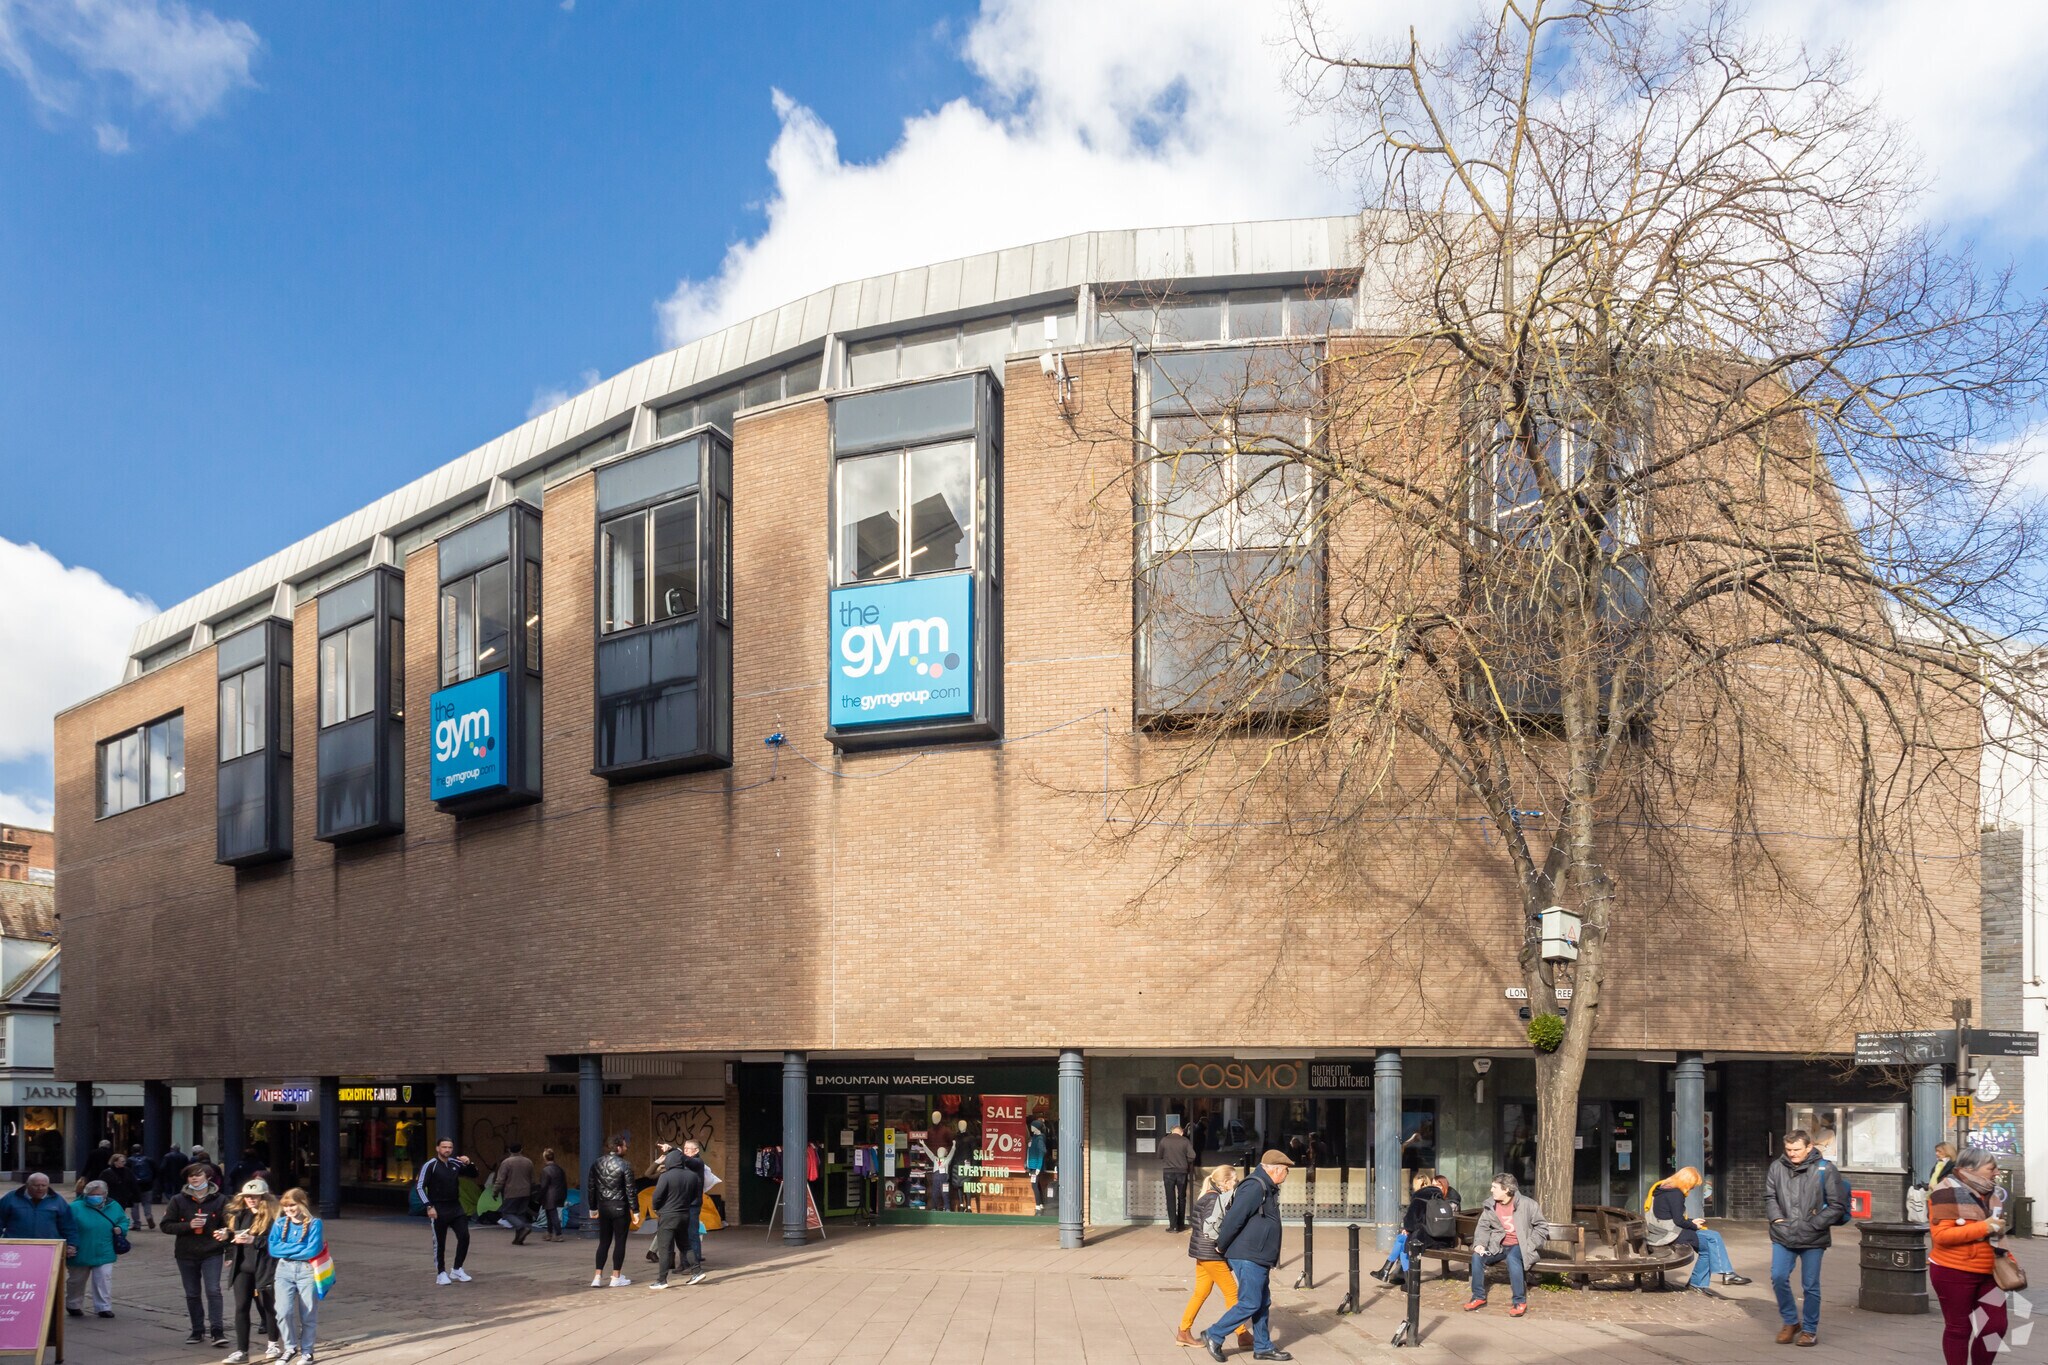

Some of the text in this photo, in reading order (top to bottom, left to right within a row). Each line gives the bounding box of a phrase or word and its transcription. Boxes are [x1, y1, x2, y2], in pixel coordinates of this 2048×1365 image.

[839, 601, 880, 627] the
[841, 617, 949, 678] gym
[841, 687, 961, 710] thegymgroup.com
[435, 701, 455, 721] the
[435, 708, 490, 762] gym
[1177, 1063, 1298, 1089] COSMO
[1311, 1065, 1351, 1076] AUTHENTIC
[825, 1075, 975, 1085] MOUNTAIN WAREHOUSE
[1311, 1076, 1370, 1087] WORLD KITCHEN
[260, 1089, 311, 1102] INTERSPORT
[354, 1088, 366, 1101] CITY
[366, 1088, 374, 1101] FC
[374, 1088, 385, 1101] FAN
[385, 1088, 397, 1101] HUB
[987, 1106, 1023, 1119] SALE
[1954, 1098, 1970, 1114] H
[973, 1149, 995, 1161] SALE
[958, 1165, 1010, 1178] EVERYTHING
[963, 1182, 1004, 1195] MUST GO!
[16, 1280, 37, 1290] the
[12, 1291, 36, 1303] Gift
